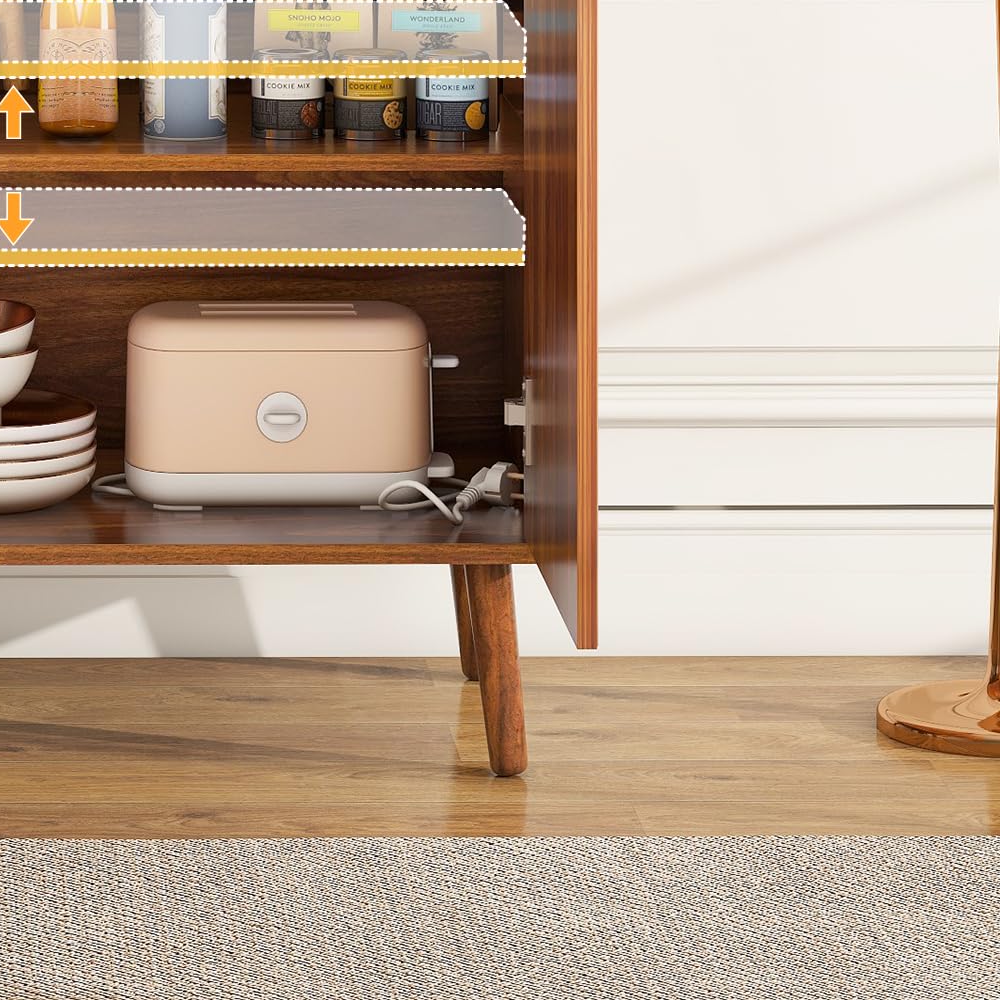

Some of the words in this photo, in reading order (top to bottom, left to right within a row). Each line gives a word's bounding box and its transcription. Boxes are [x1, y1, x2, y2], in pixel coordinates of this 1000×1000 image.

[319, 14, 342, 22] MOJO
[409, 15, 466, 23] WONDERLAND
[349, 83, 378, 91] COOKIE
